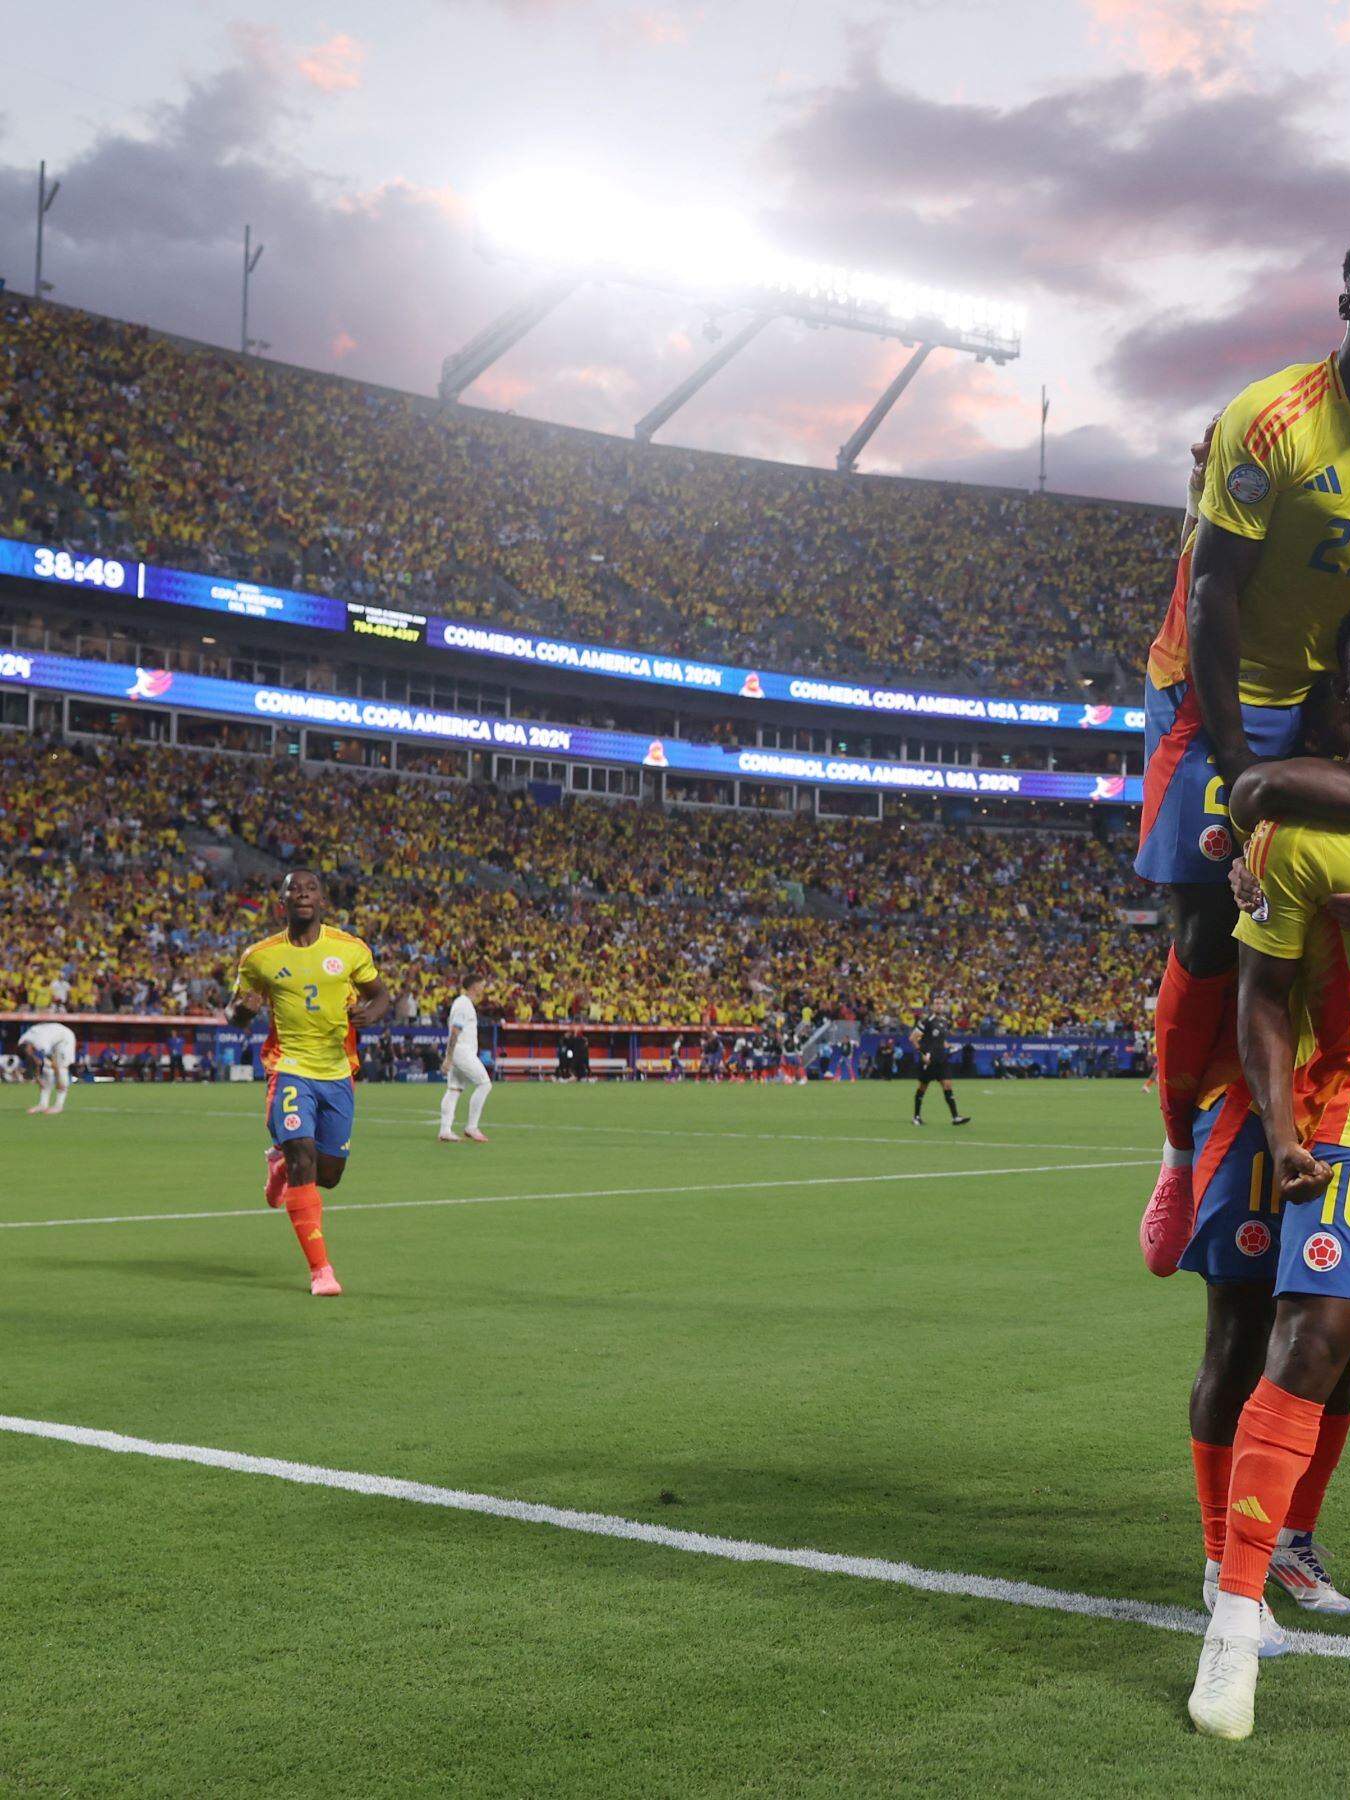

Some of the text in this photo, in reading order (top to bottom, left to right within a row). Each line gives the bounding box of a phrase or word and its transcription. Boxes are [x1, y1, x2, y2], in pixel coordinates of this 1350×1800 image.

[34, 548, 125, 589] 38:49
[0, 653, 32, 679] 24
[443, 625, 722, 686] CONMEBOL COPA AMERICA USA 2024
[255, 690, 571, 750] CONMEBOL COPA AMERICA USA 2024
[789, 680, 1060, 722] CONMEBOL COPA AMERICA USA 2024
[738, 753, 1020, 792] CONMEBOL COPA AMERICA USA 2024
[304, 984, 320, 1011] 2
[282, 1086, 298, 1113] 2
